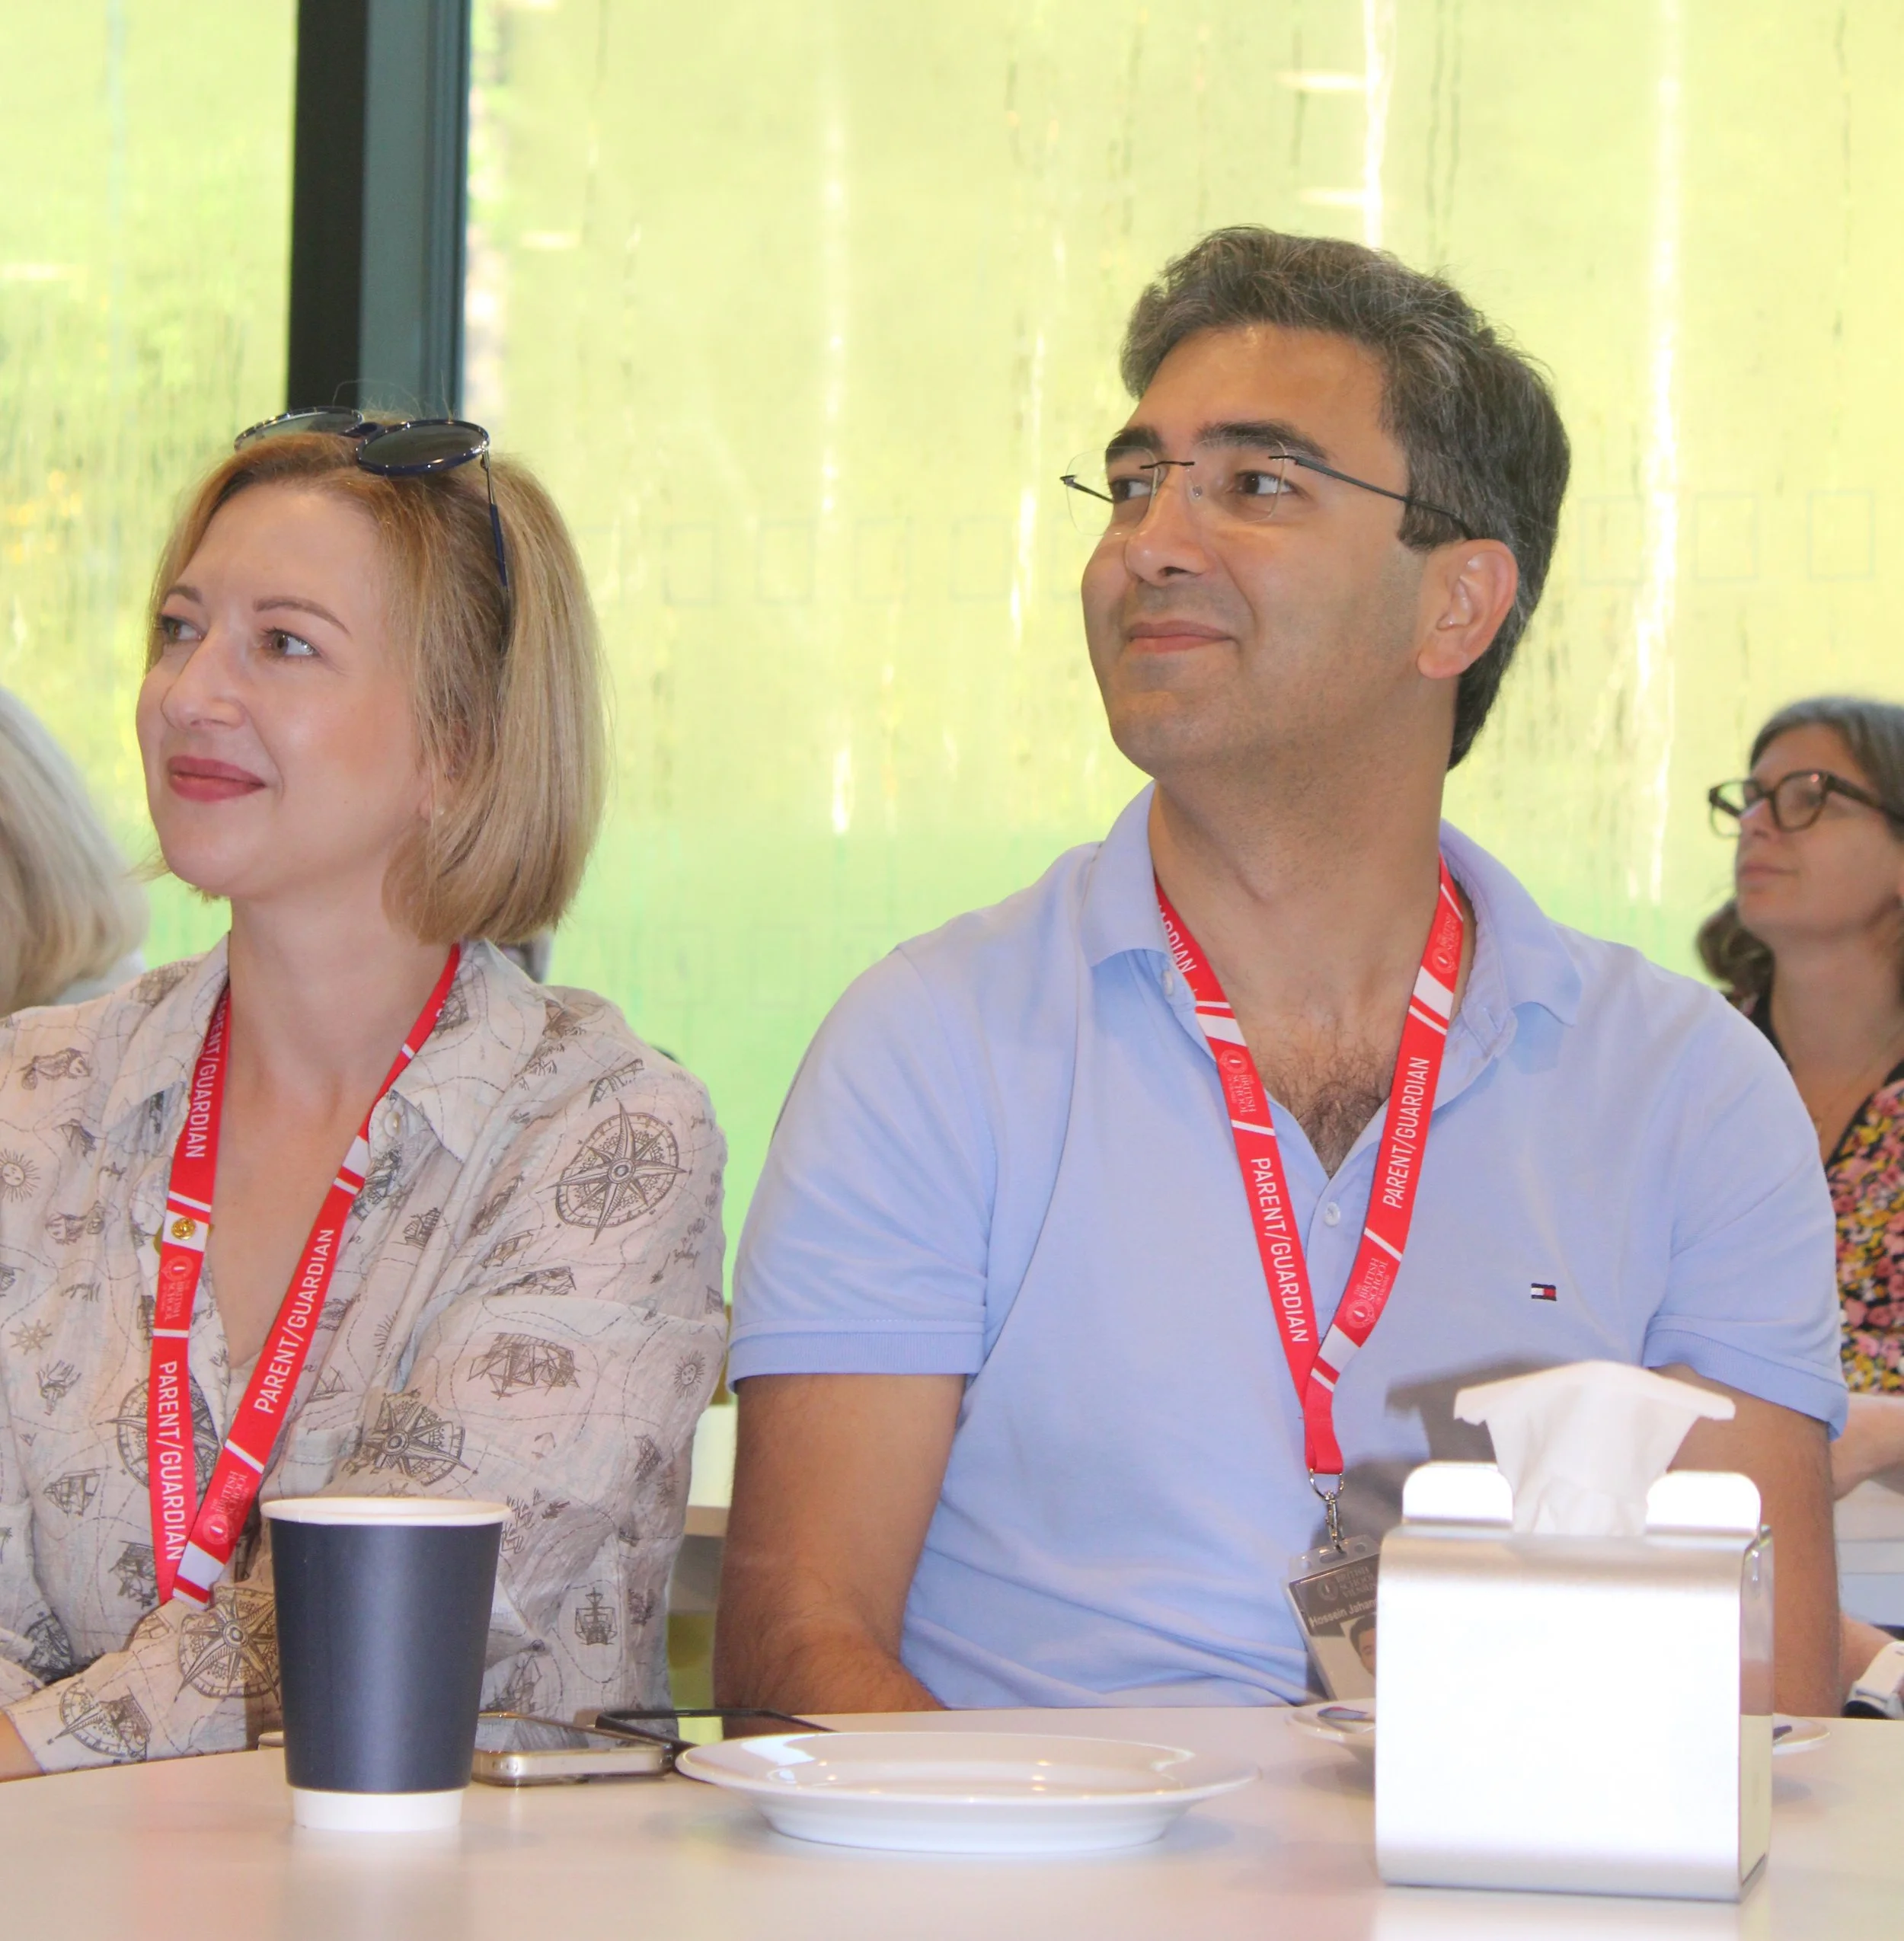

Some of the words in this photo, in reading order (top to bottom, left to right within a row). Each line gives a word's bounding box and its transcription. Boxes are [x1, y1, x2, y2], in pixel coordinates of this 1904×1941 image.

[1382, 1057, 1430, 1209] PARENT/GUARDIAN
[1250, 1157, 1309, 1342] PARENT/GUARDIAN
[1359, 1257, 1380, 1299] BRITISH
[1367, 1261, 1388, 1301] SCHOOL
[254, 1229, 334, 1414] PARENT/GUARDIAN
[156, 1360, 187, 1560] PARENT/GUARDIAN
[216, 1470, 238, 1513] BRITISH
[226, 1473, 248, 1515] SCHOOL
[1308, 1607, 1347, 1627] Hossein
